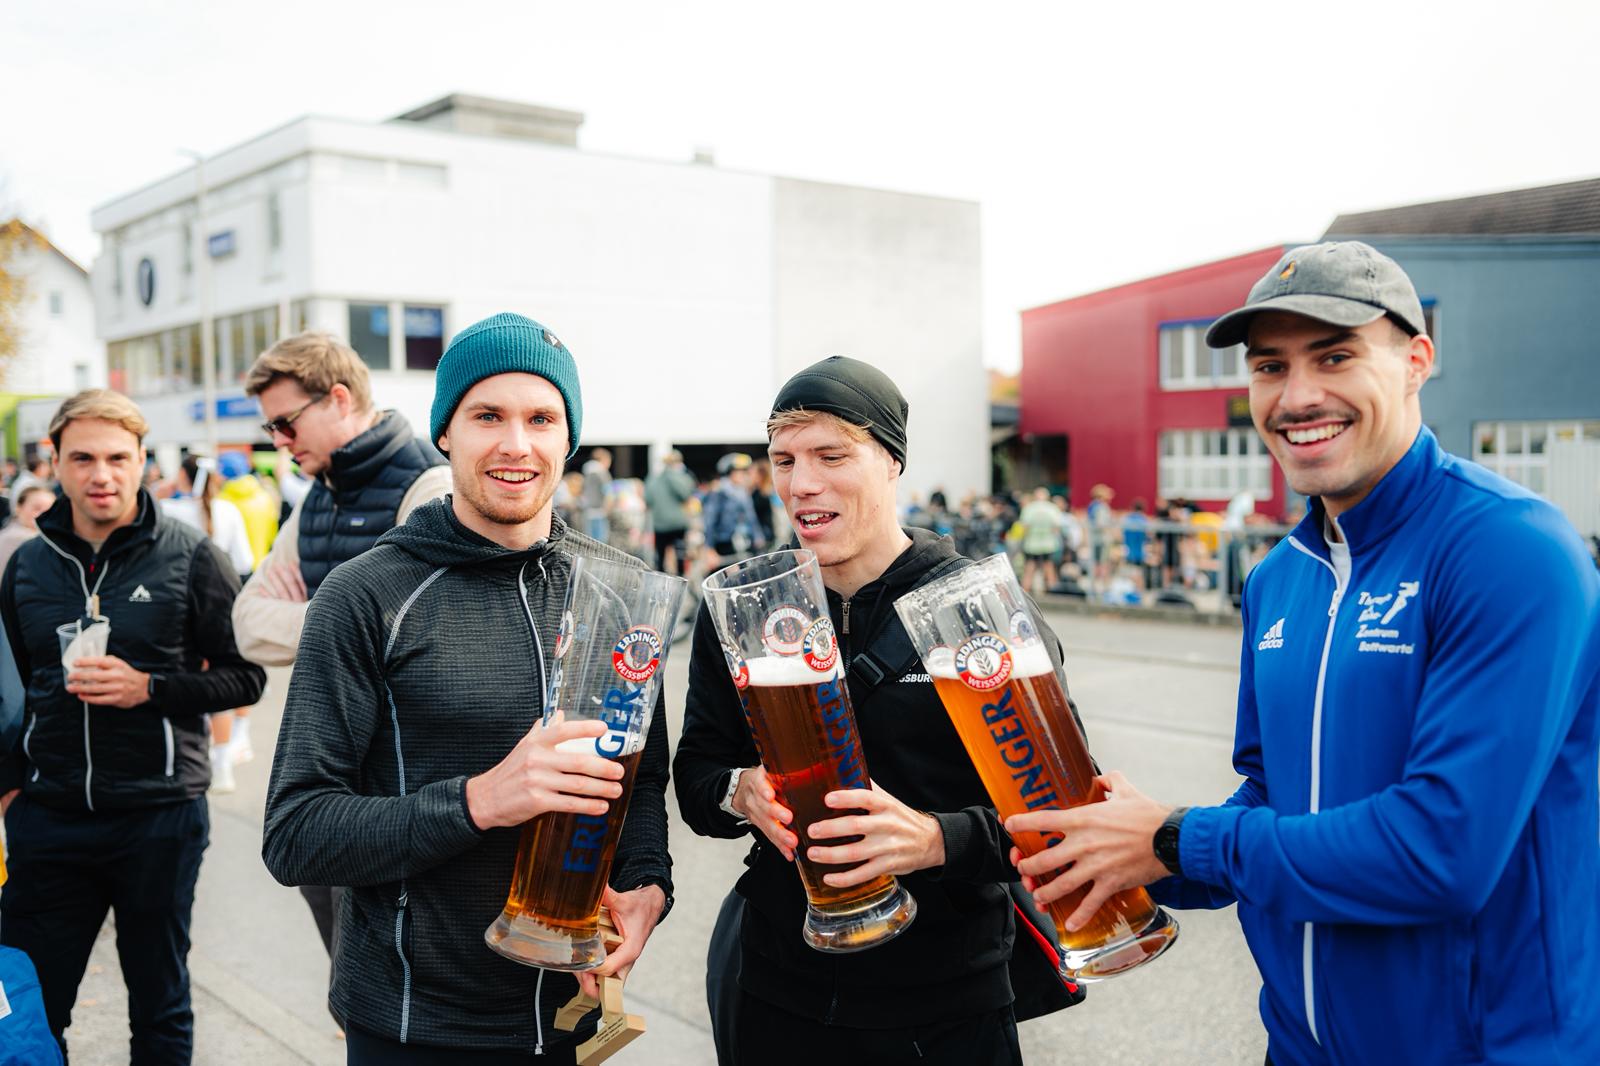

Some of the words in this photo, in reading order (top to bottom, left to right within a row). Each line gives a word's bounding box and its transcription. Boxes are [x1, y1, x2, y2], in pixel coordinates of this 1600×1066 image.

[617, 632, 660, 655] ERDINGER
[956, 636, 1004, 667] ERDINGER
[1258, 638, 1284, 650] adidas
